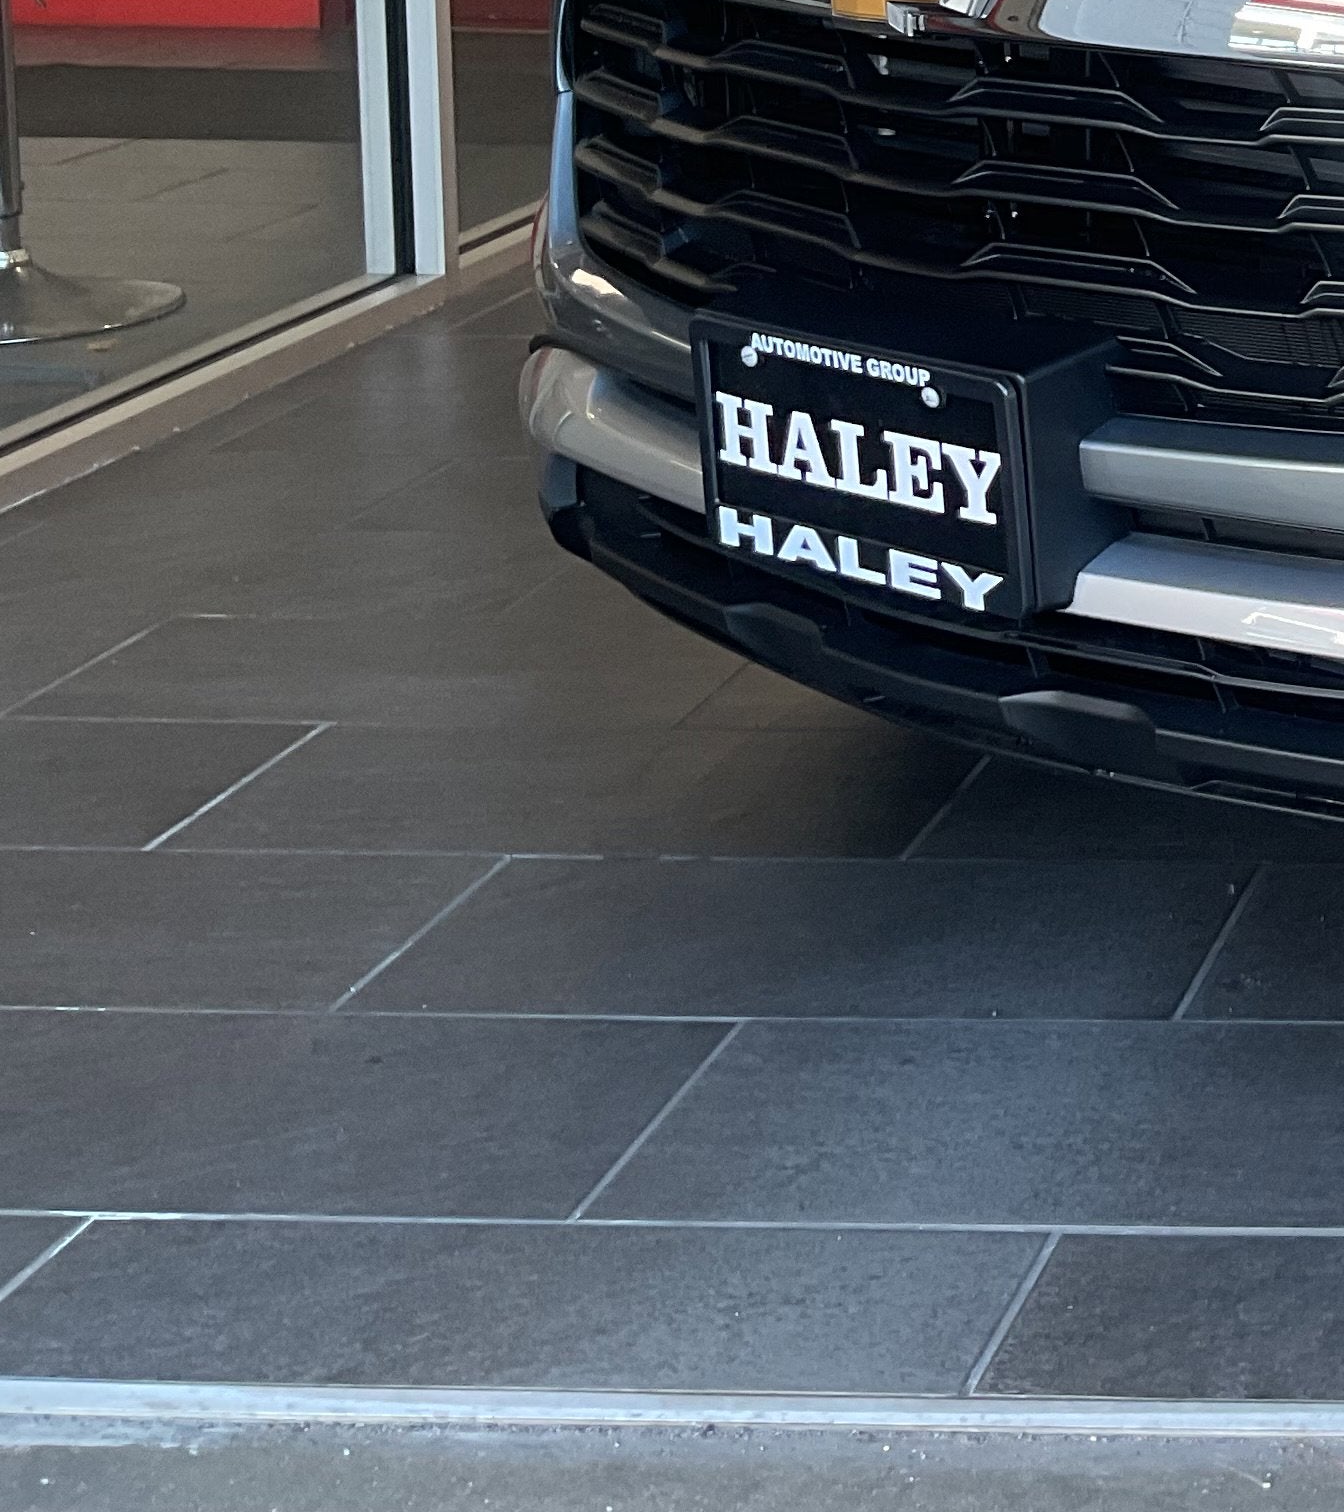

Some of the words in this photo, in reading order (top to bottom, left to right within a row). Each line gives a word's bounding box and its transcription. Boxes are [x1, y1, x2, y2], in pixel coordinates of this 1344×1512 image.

[750, 332, 863, 374] AUTOMOTIVE
[866, 358, 931, 387] GROUP
[715, 390, 1002, 525] HALEY
[718, 505, 1004, 612] HALEY
